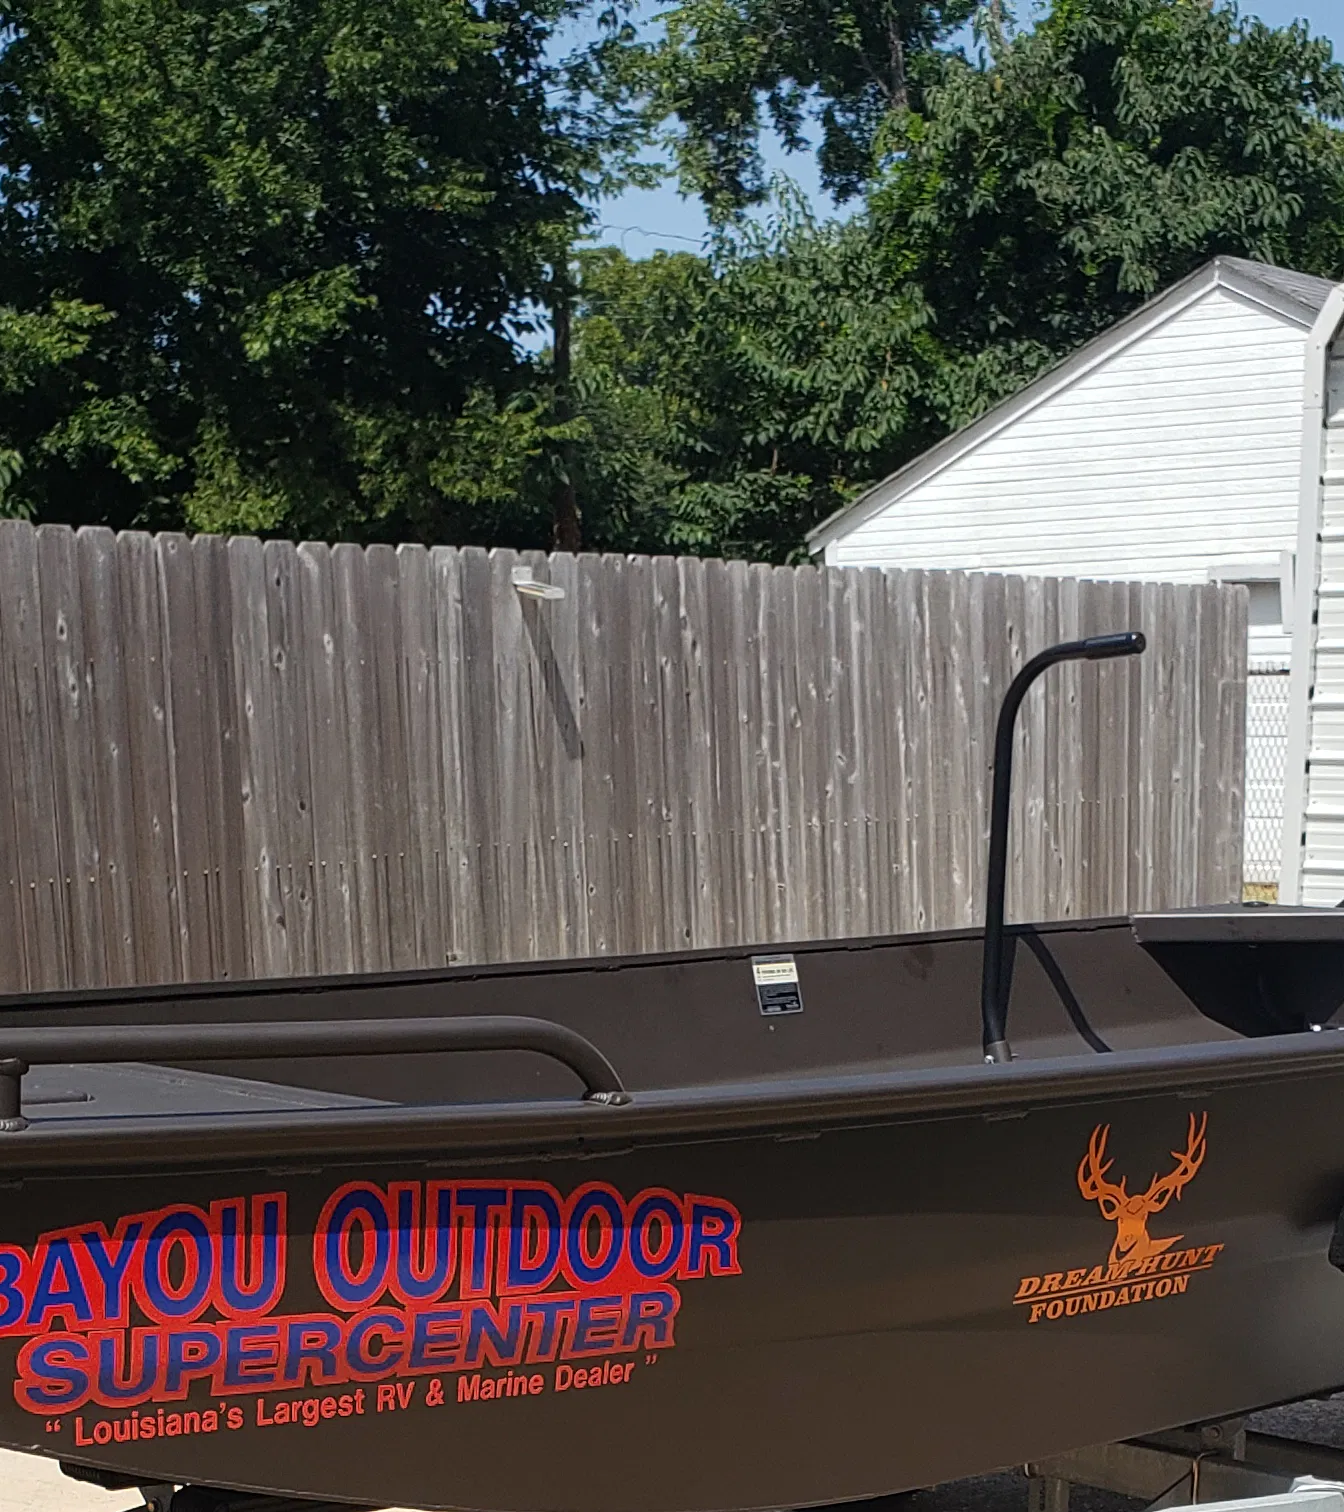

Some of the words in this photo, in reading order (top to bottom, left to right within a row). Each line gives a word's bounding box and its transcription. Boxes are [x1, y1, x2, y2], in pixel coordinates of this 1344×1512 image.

[319, 1184, 737, 1307] OUTDOOR
[1014, 1260, 1136, 1298] DREAM
[1135, 1244, 1225, 1275] HUNT
[1028, 1275, 1191, 1323] FOUNDATION
[20, 1288, 677, 1410] SUPERCENTER
[74, 1402, 245, 1447] Louisiana's
[256, 1389, 364, 1427] Largest
[376, 1381, 416, 1413] RV
[425, 1379, 445, 1407] &
[457, 1371, 545, 1404] Marine
[554, 1360, 636, 1391] Dealer
